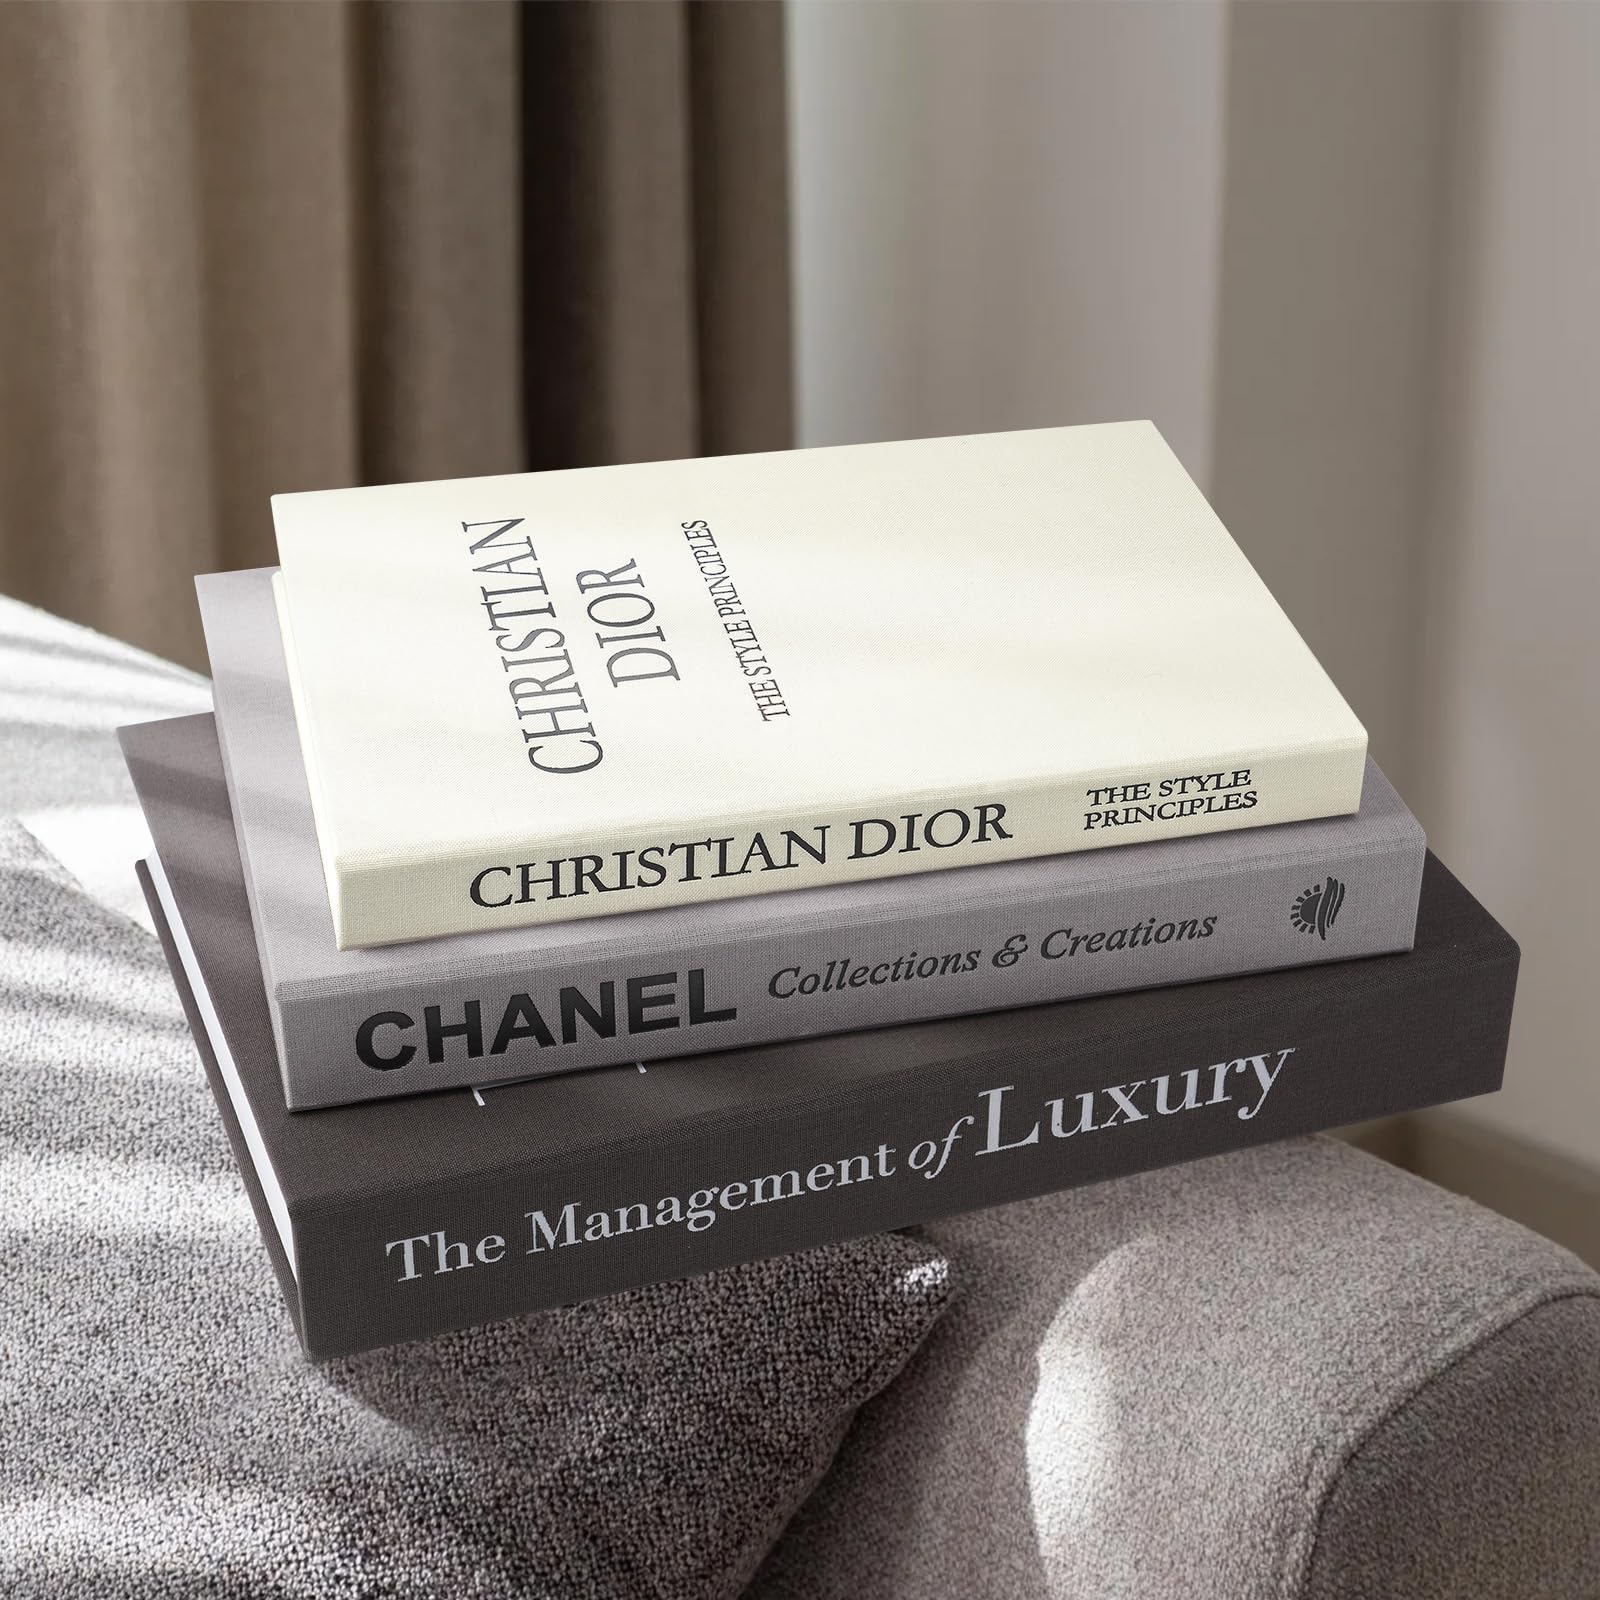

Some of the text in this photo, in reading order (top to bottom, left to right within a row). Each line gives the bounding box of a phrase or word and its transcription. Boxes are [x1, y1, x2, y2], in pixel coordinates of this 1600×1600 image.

[461, 517, 604, 775] CHRISTIAN
[575, 558, 681, 688] DIOR
[680, 519, 791, 722] THE STYLE PRINCIPLES
[1083, 790, 1259, 831] PRINCIPLES
[1086, 769, 1252, 807] THE STYLE
[469, 802, 1014, 908] CHRISTIAN DIOR
[768, 912, 1218, 1000] Collections & Creations
[355, 968, 738, 1072] CHANEL
[386, 1046, 1297, 1283] The Management of Luxury
